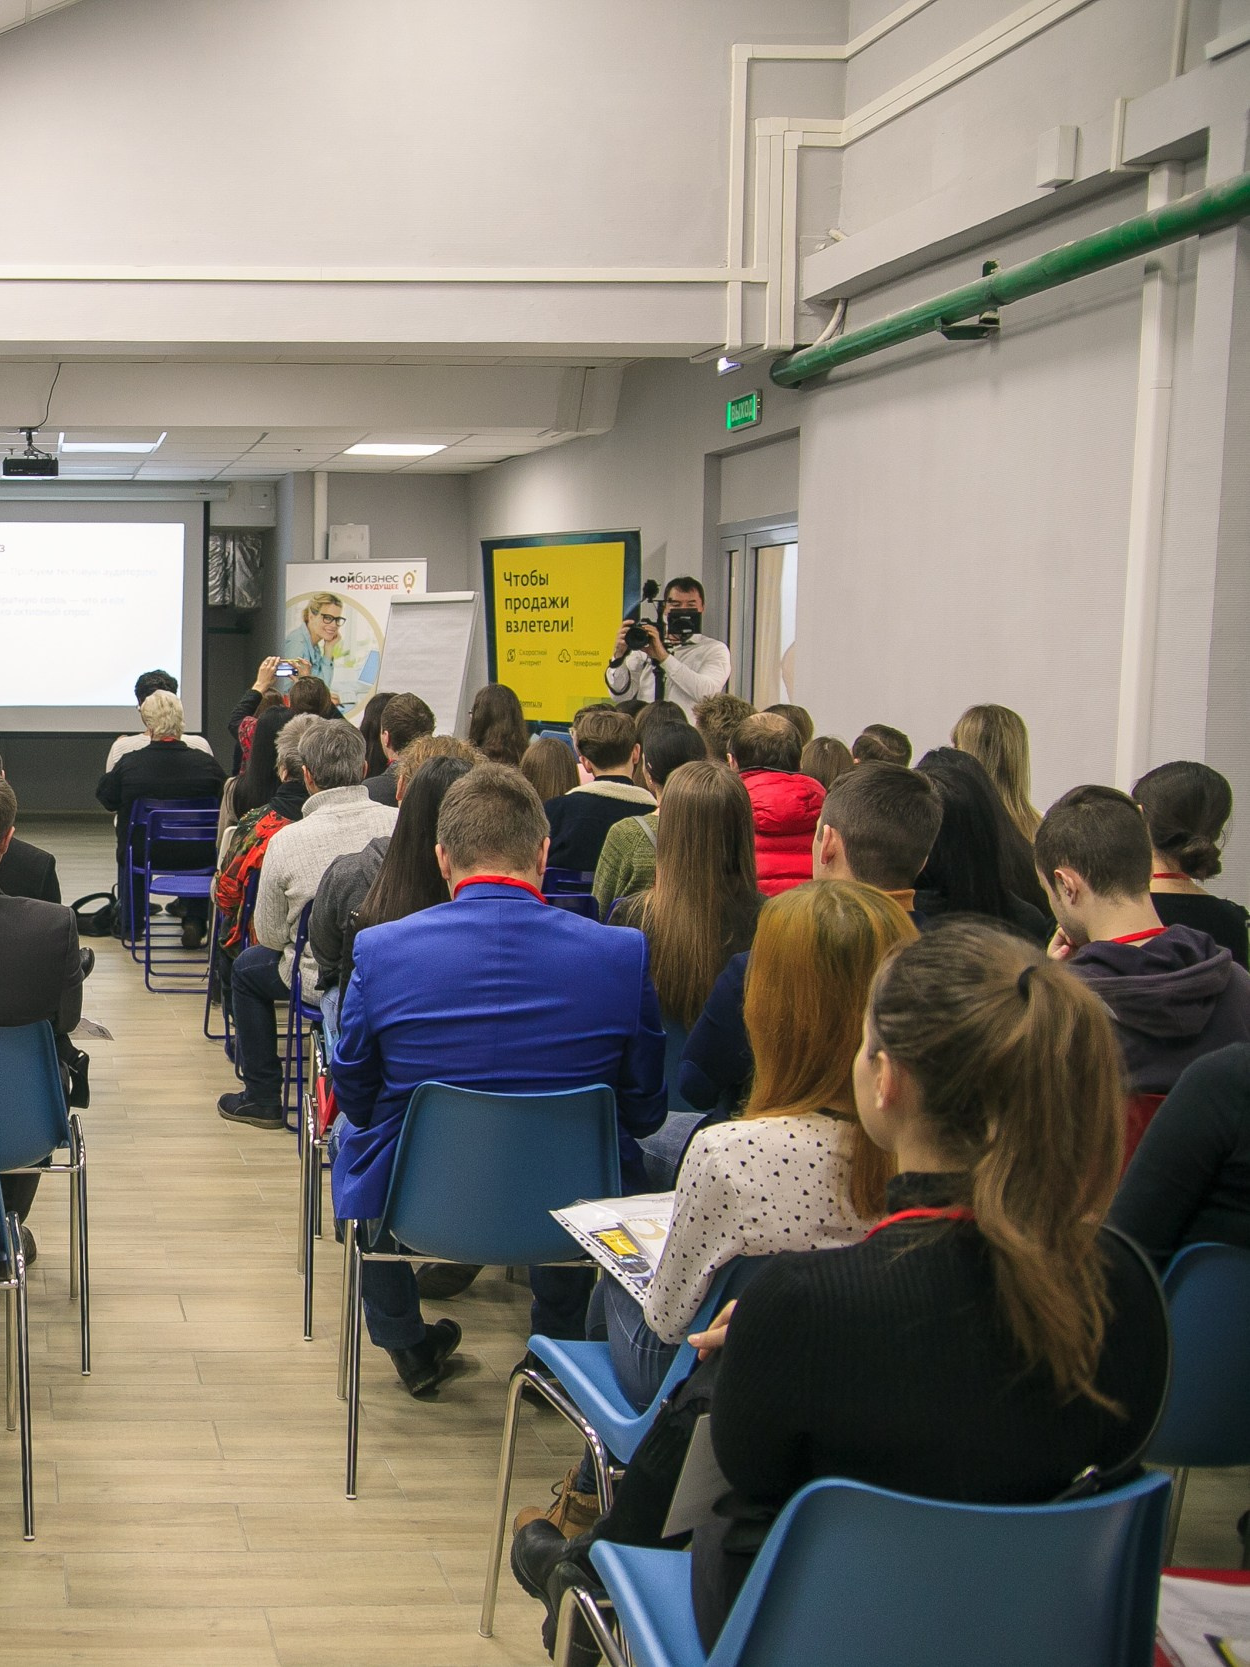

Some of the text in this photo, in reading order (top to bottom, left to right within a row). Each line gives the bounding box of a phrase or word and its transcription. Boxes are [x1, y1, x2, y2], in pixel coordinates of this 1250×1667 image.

[503, 569, 549, 587] Чтобы
[505, 596, 569, 614] продажи
[506, 616, 574, 633] взлетели!
